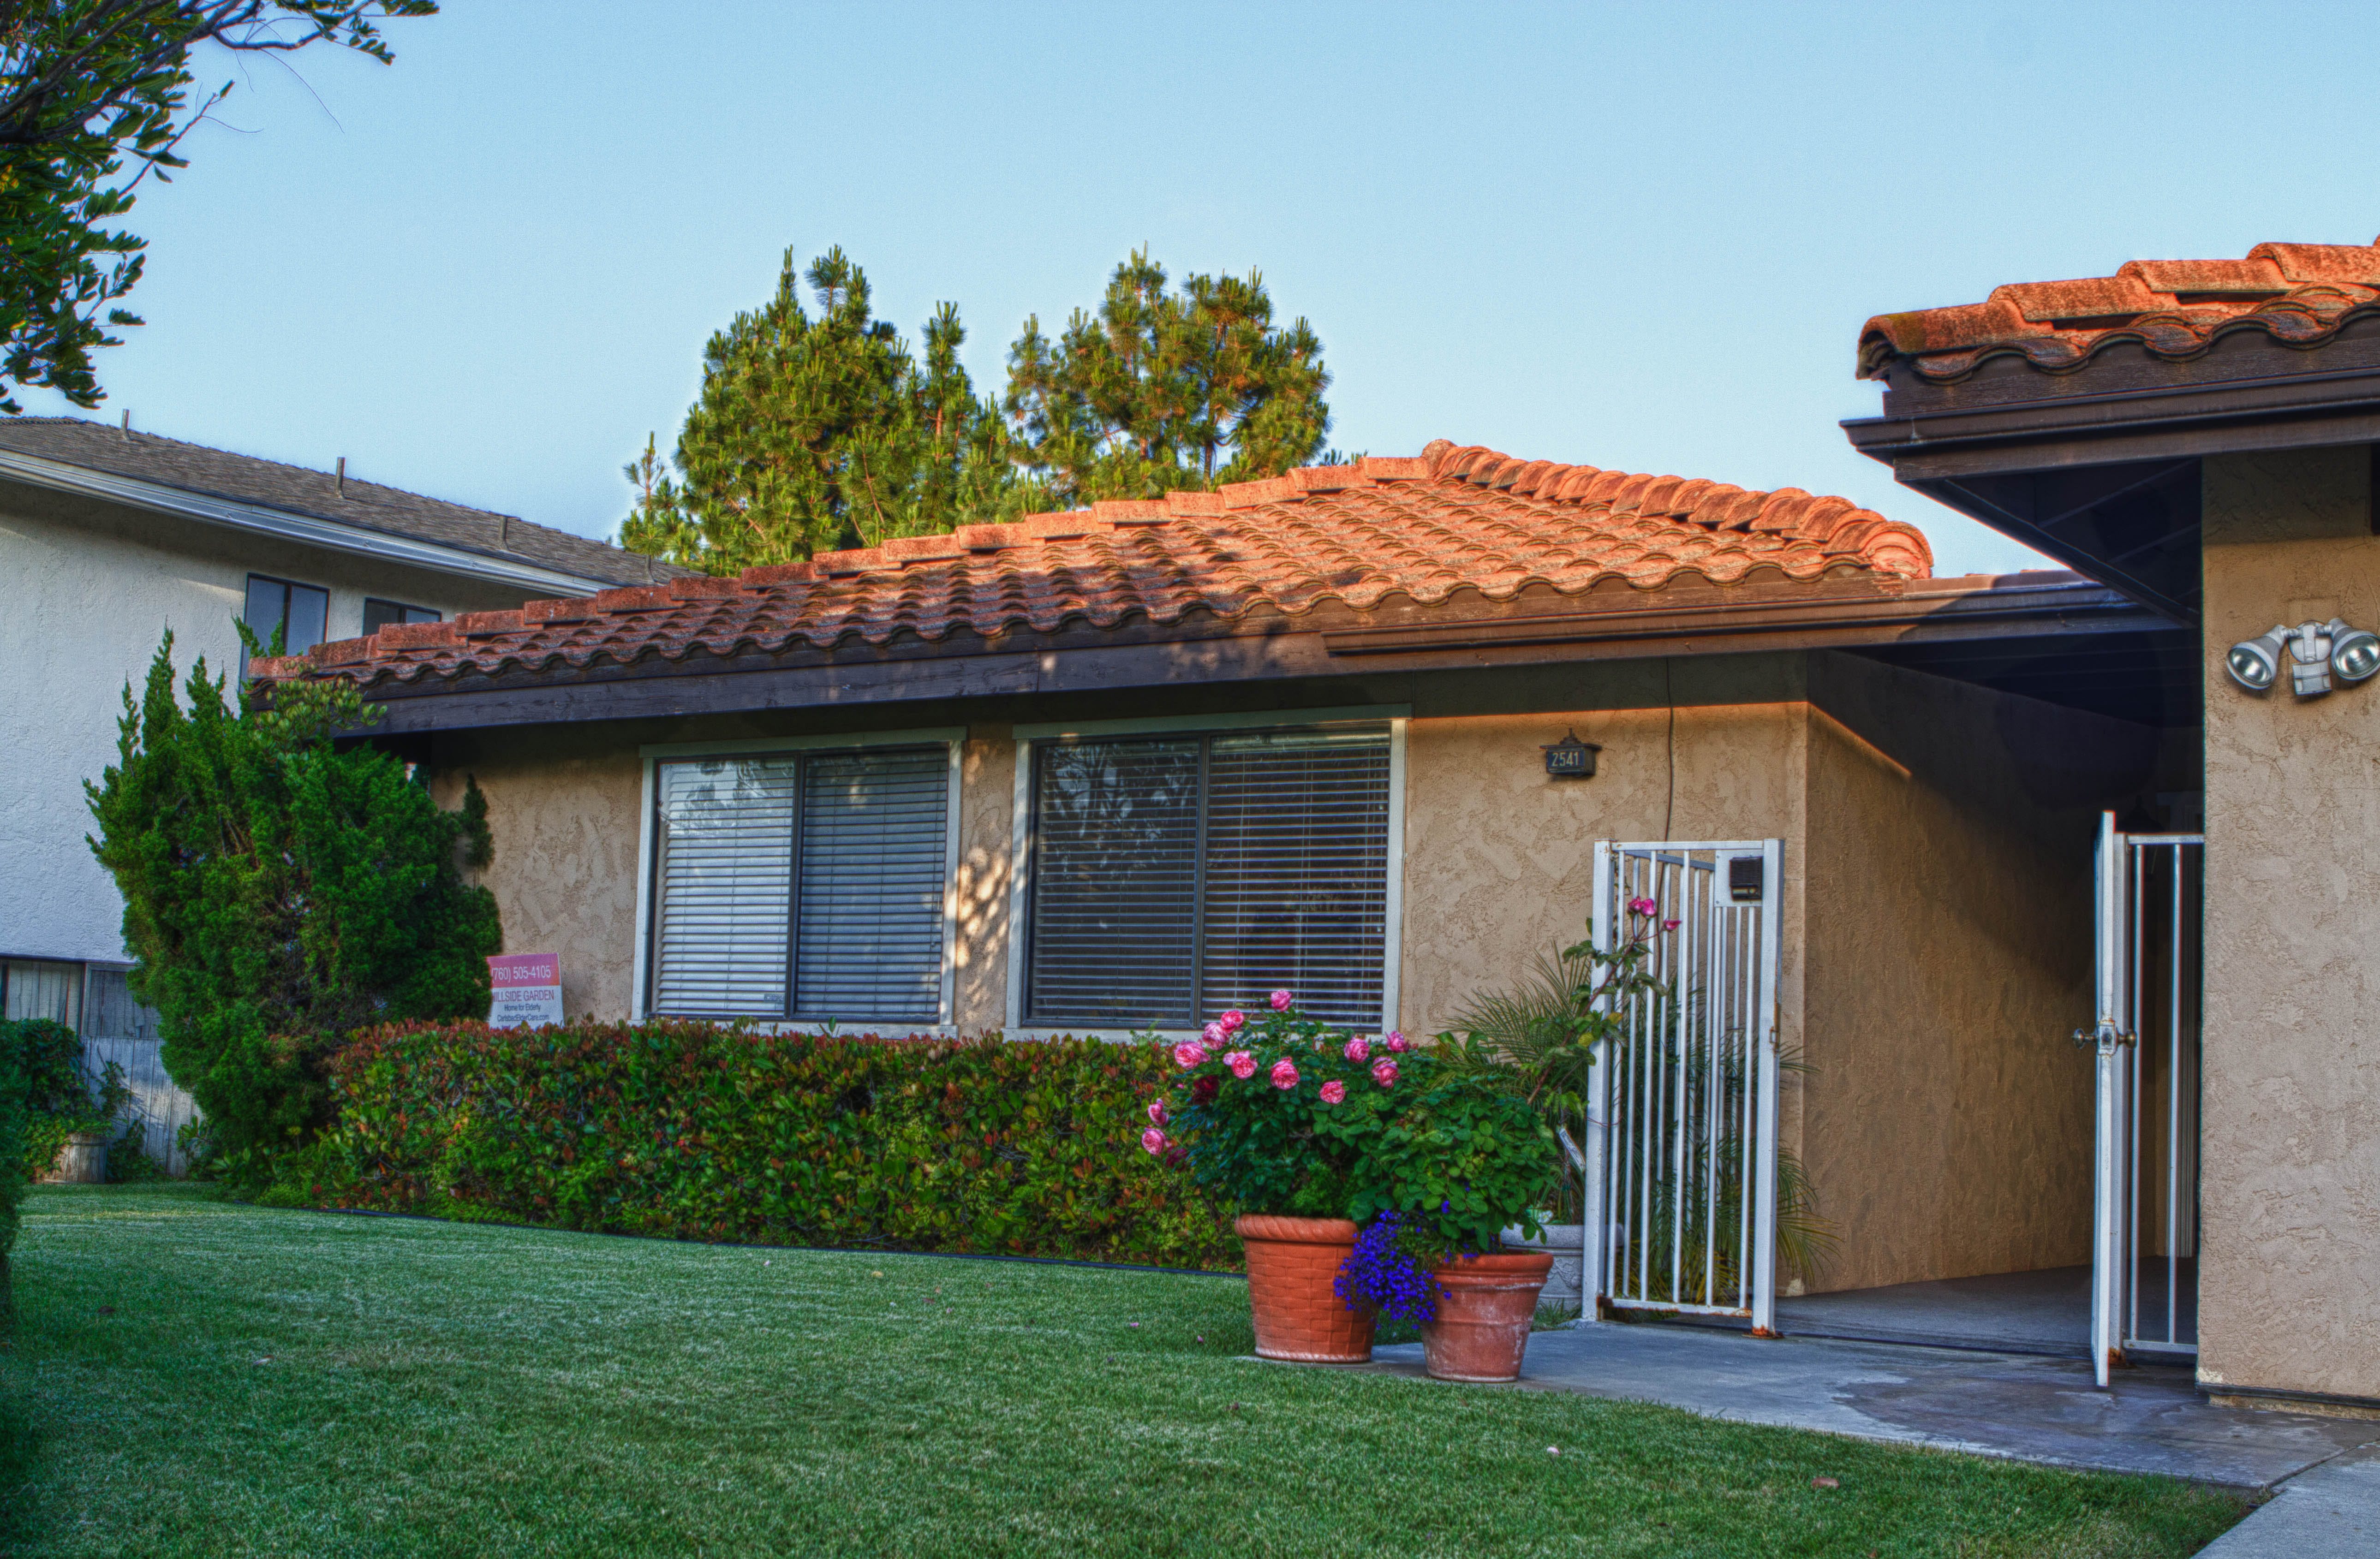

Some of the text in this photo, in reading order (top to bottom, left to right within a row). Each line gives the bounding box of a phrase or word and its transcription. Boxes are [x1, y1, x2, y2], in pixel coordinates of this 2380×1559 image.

[1551, 751, 1579, 767] 2541
[491, 965, 551, 983] (760) 505-4105
[523, 989, 555, 1001] GARDEN
[525, 1003, 541, 1012] Elderly
